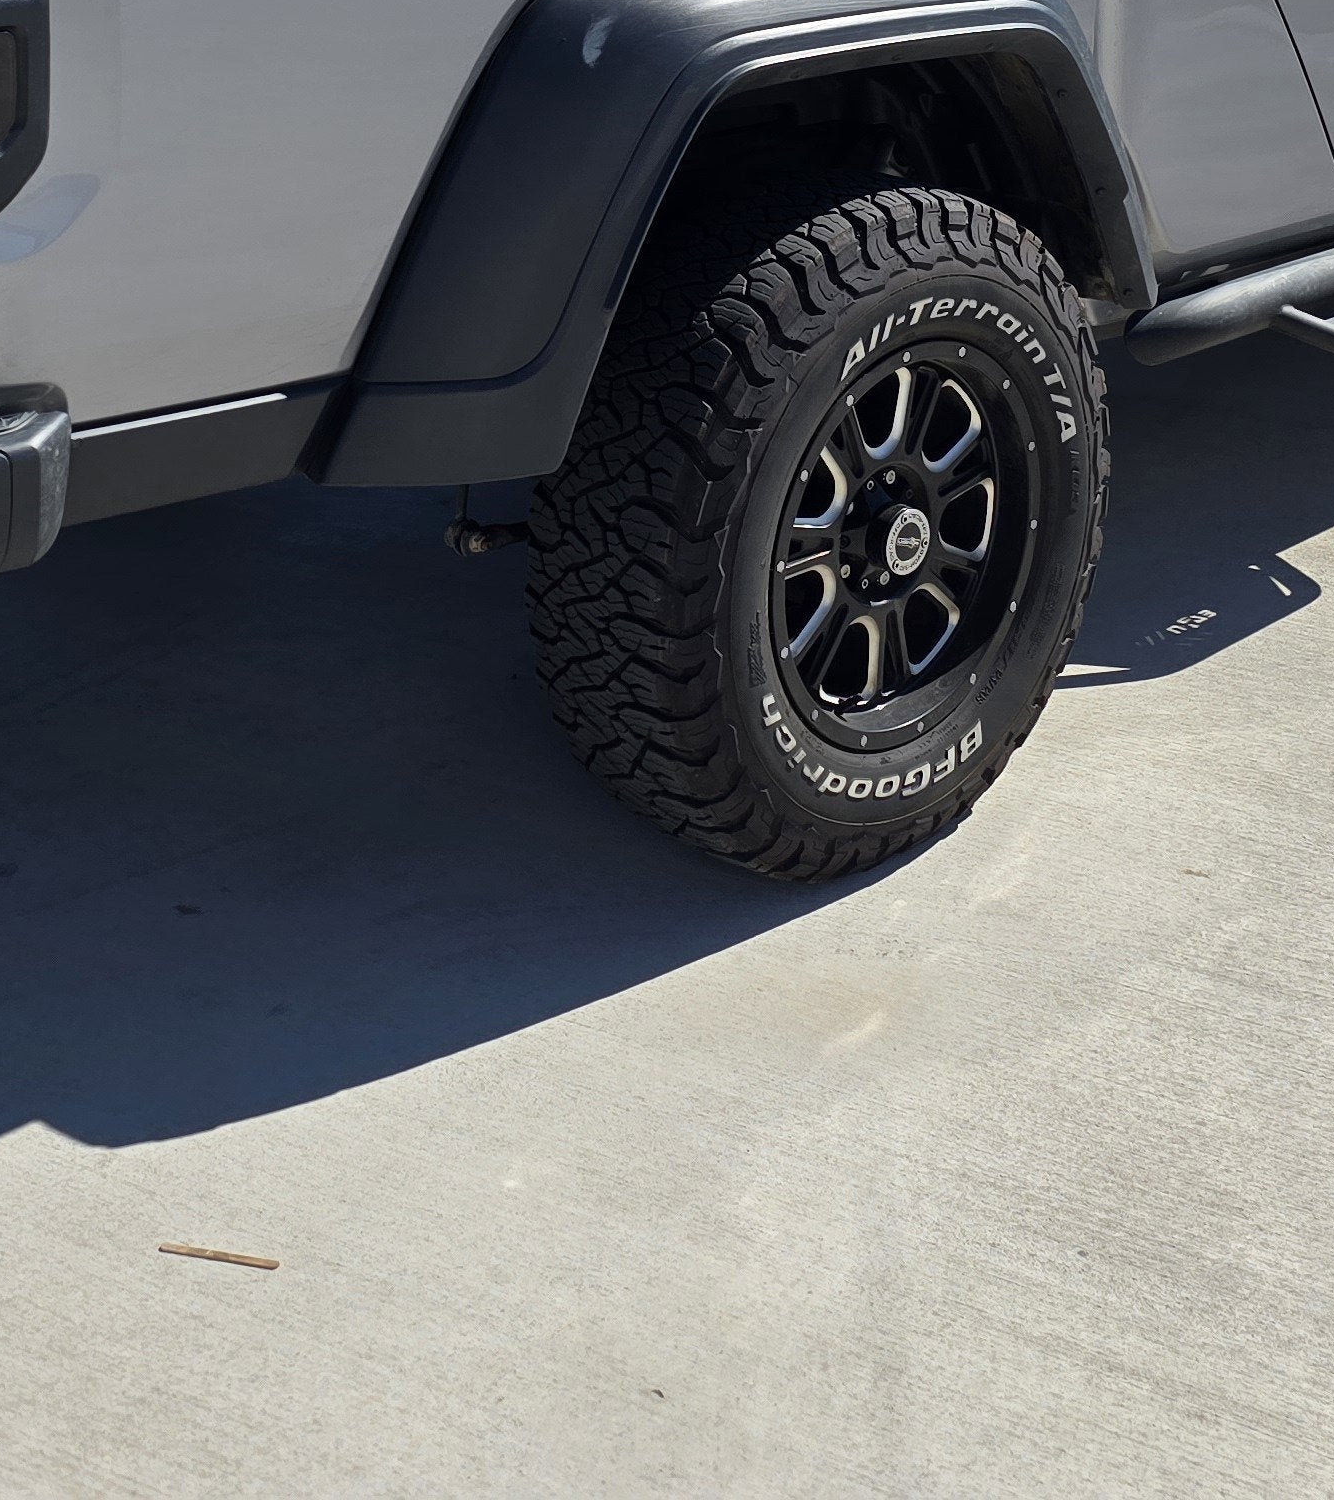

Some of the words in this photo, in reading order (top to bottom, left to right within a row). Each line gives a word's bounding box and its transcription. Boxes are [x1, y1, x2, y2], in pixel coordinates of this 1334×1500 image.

[840, 296, 1047, 382] All-Terrain
[1042, 362, 1078, 443] T/A
[762, 693, 984, 799] BFGoodrich
